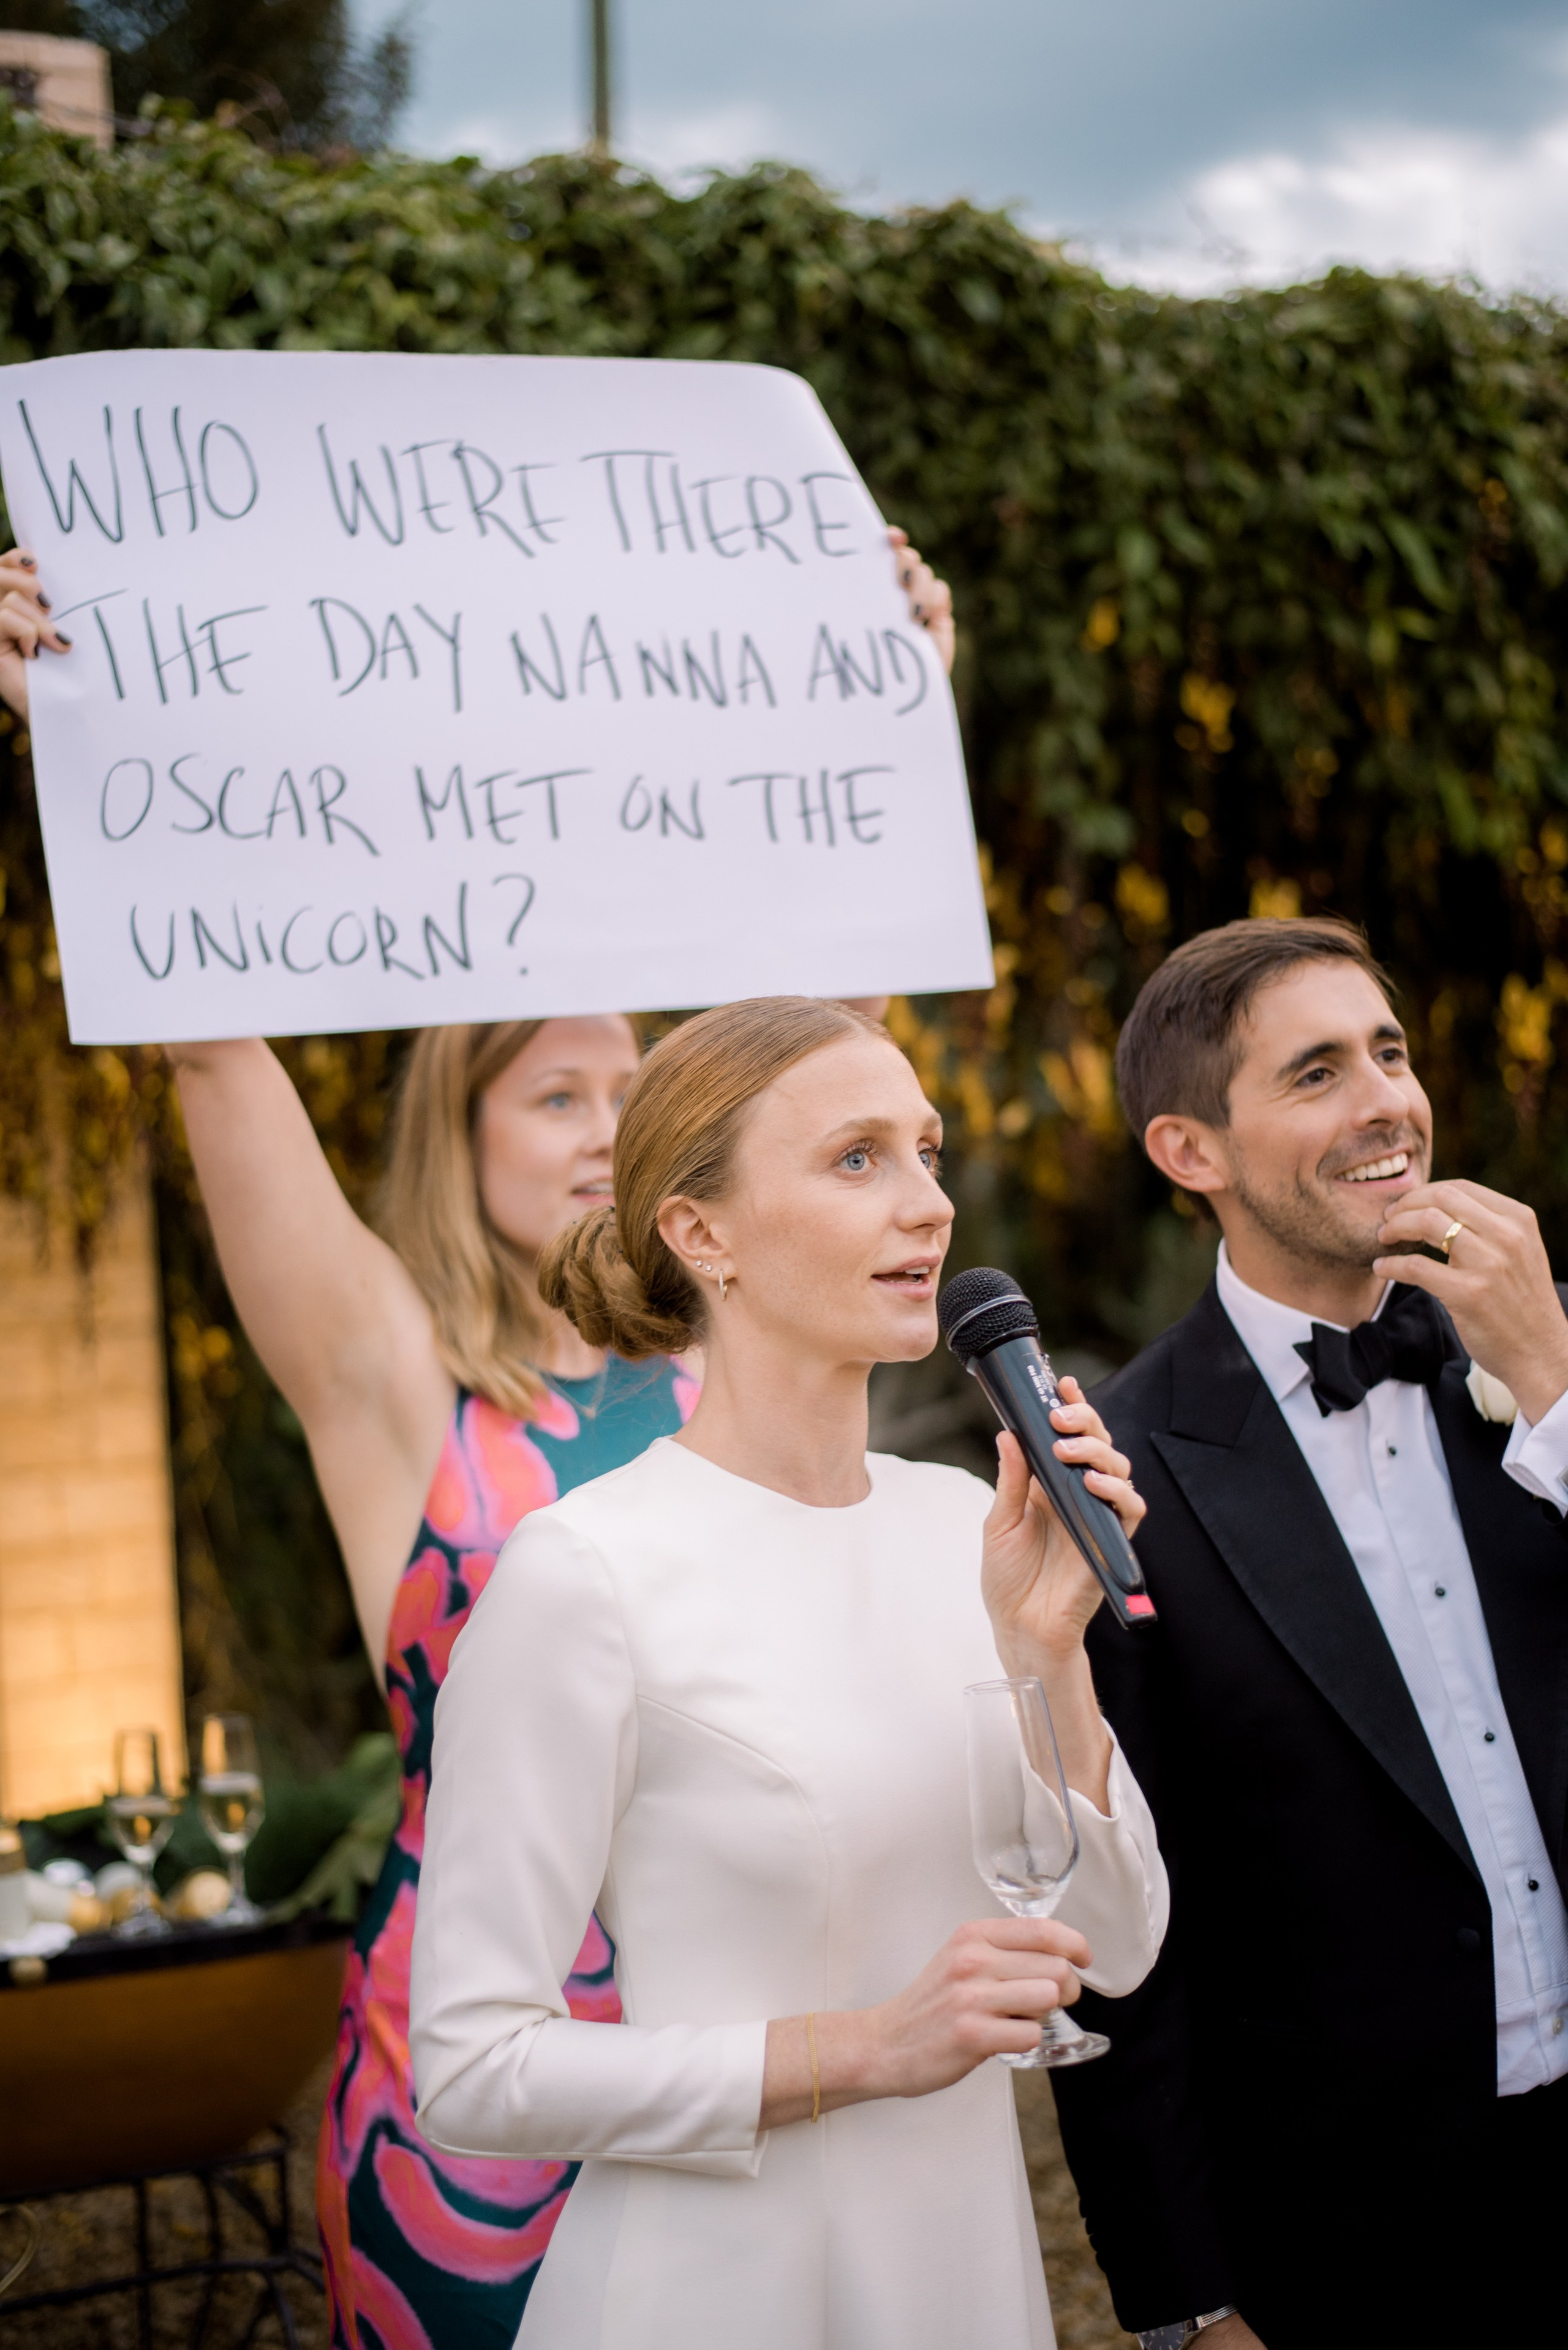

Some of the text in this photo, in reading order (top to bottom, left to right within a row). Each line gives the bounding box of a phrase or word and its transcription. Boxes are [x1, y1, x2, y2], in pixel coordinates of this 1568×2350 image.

[17, 399, 861, 565] WHO WERE THERE
[51, 588, 929, 717] THE DAY NANNA AND
[100, 753, 896, 857] OSCAR MET ON THE
[1027, 1365, 1037, 1377] PRO
